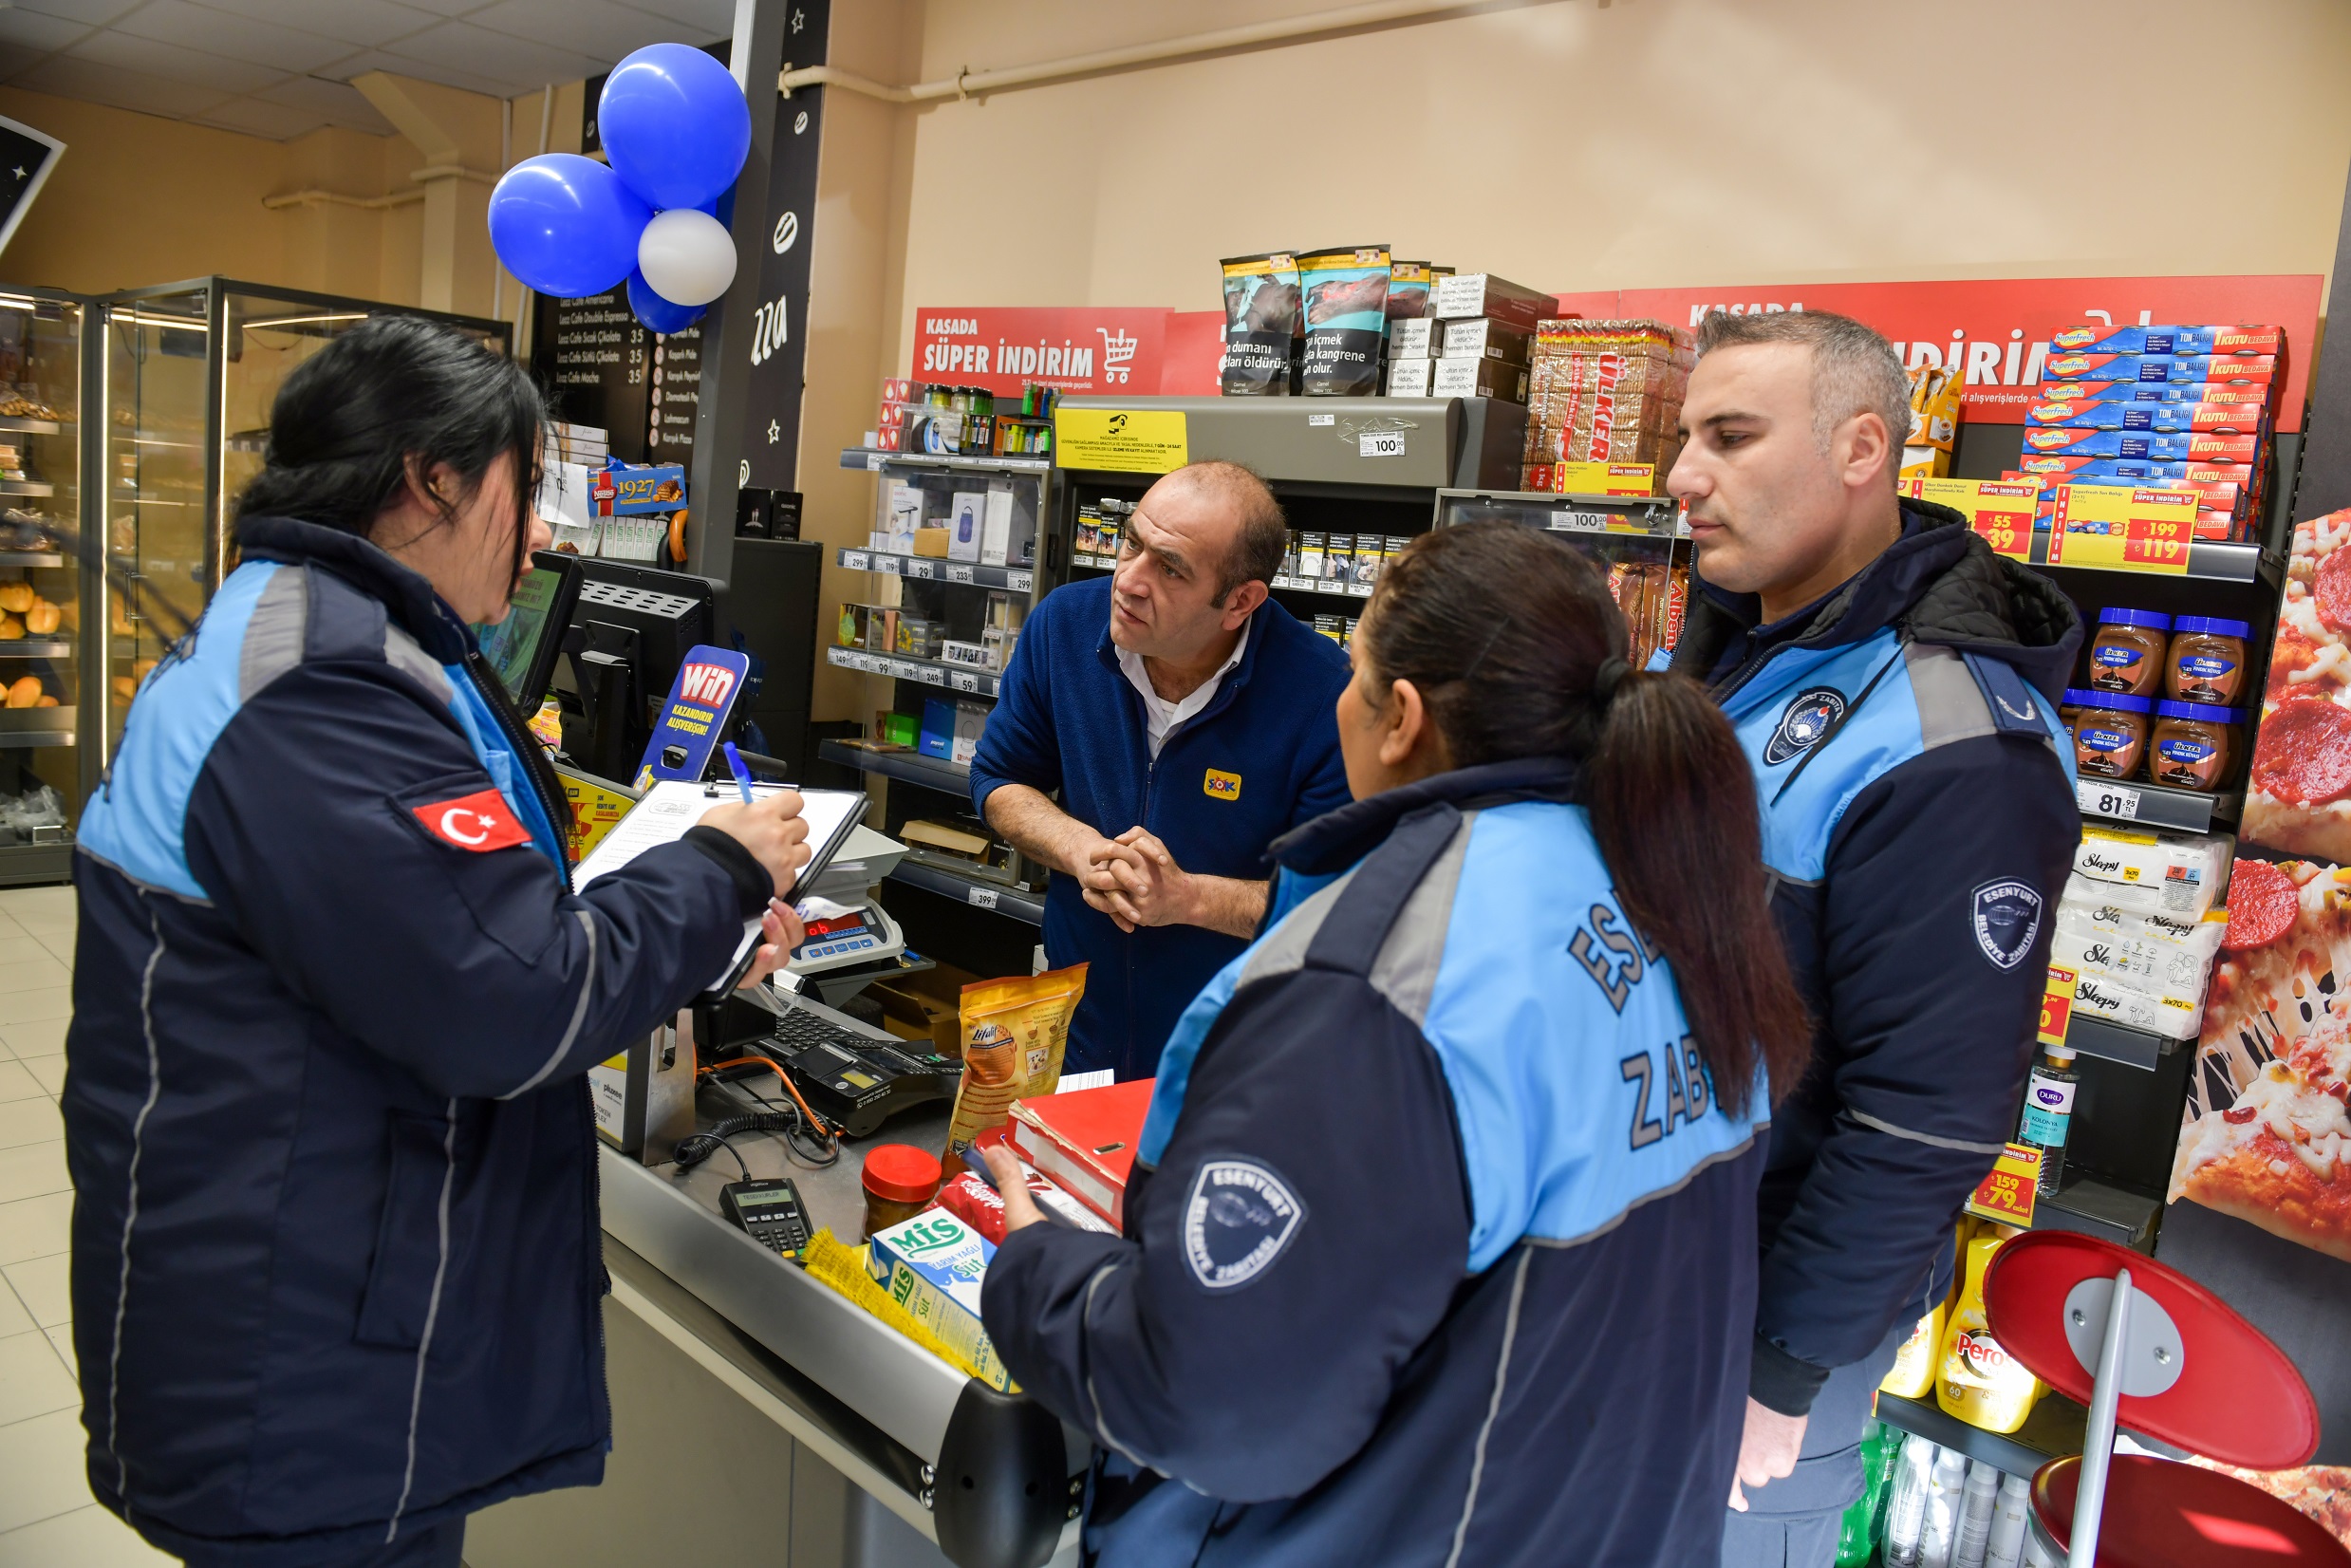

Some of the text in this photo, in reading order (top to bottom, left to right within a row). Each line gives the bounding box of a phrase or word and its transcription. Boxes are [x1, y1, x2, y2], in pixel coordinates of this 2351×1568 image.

[926, 319, 978, 335] KASADA
[630, 329, 644, 344] 35
[1314, 333, 1343, 348] içmek
[2054, 332, 2095, 343] SuperFresh
[1232, 341, 1272, 354] dumanı
[629, 349, 643, 364] 35
[924, 337, 1093, 378] SÜPER İNDİRİM
[1316, 347, 1365, 362] kangrene
[1313, 362, 1333, 374] olur.
[2049, 361, 2090, 370] SuperFresh
[628, 369, 641, 383] 35
[1969, 392, 2028, 404] alışverişlerde
[2044, 387, 2084, 397] SuperFresh
[1588, 352, 1627, 462] ÜLKER
[2032, 406, 2073, 416] SuperFresh
[2029, 434, 2070, 443] SuperFresh
[2024, 461, 2065, 471] SuperFresh
[618, 479, 656, 499] 1927
[1993, 515, 2011, 528] 55
[2150, 523, 2177, 536] 199
[1987, 529, 2015, 549] 39
[2143, 538, 2179, 559] 119
[852, 558, 863, 568] 299
[886, 563, 895, 571] 119
[919, 568, 928, 578] 29
[956, 571, 968, 581] 233
[1017, 580, 1030, 589] 299
[835, 655, 846, 663] 149
[879, 664, 888, 674] 99
[904, 668, 913, 677] 119
[926, 673, 939, 682] 249
[681, 665, 735, 706] Win
[962, 681, 973, 690] 59
[1819, 695, 1841, 713] ZABITA
[672, 704, 714, 723] KAZANDIRIR
[666, 717, 709, 736] ALIŞVERİŞİN!
[2094, 731, 2119, 741] ÜLKER
[2174, 742, 2200, 753] ÜLKER
[2082, 852, 2119, 871] Sleepy
[979, 895, 992, 905] 399
[1983, 887, 2038, 906] ESENYURT
[1978, 914, 2035, 961] BELEDİYE ZABITASI
[2074, 981, 2120, 1010] Sleepy
[2163, 998, 2183, 1008] 3x70
[604, 1084, 623, 1099] pluxee
[1619, 1032, 1720, 1152] ZAB
[2040, 1092, 2062, 1101] DURU
[596, 1104, 611, 1118] TOKEN
[2032, 1116, 2059, 1127] KOLONYA
[1996, 1174, 2020, 1190] 159
[1212, 1168, 1292, 1217] ESENYURT
[1988, 1186, 2028, 1214] 79 adet
[929, 1243, 981, 1271] YARIM YAĞLI
[954, 1259, 988, 1277] Süt
[1949, 1385, 1961, 1397] 60
